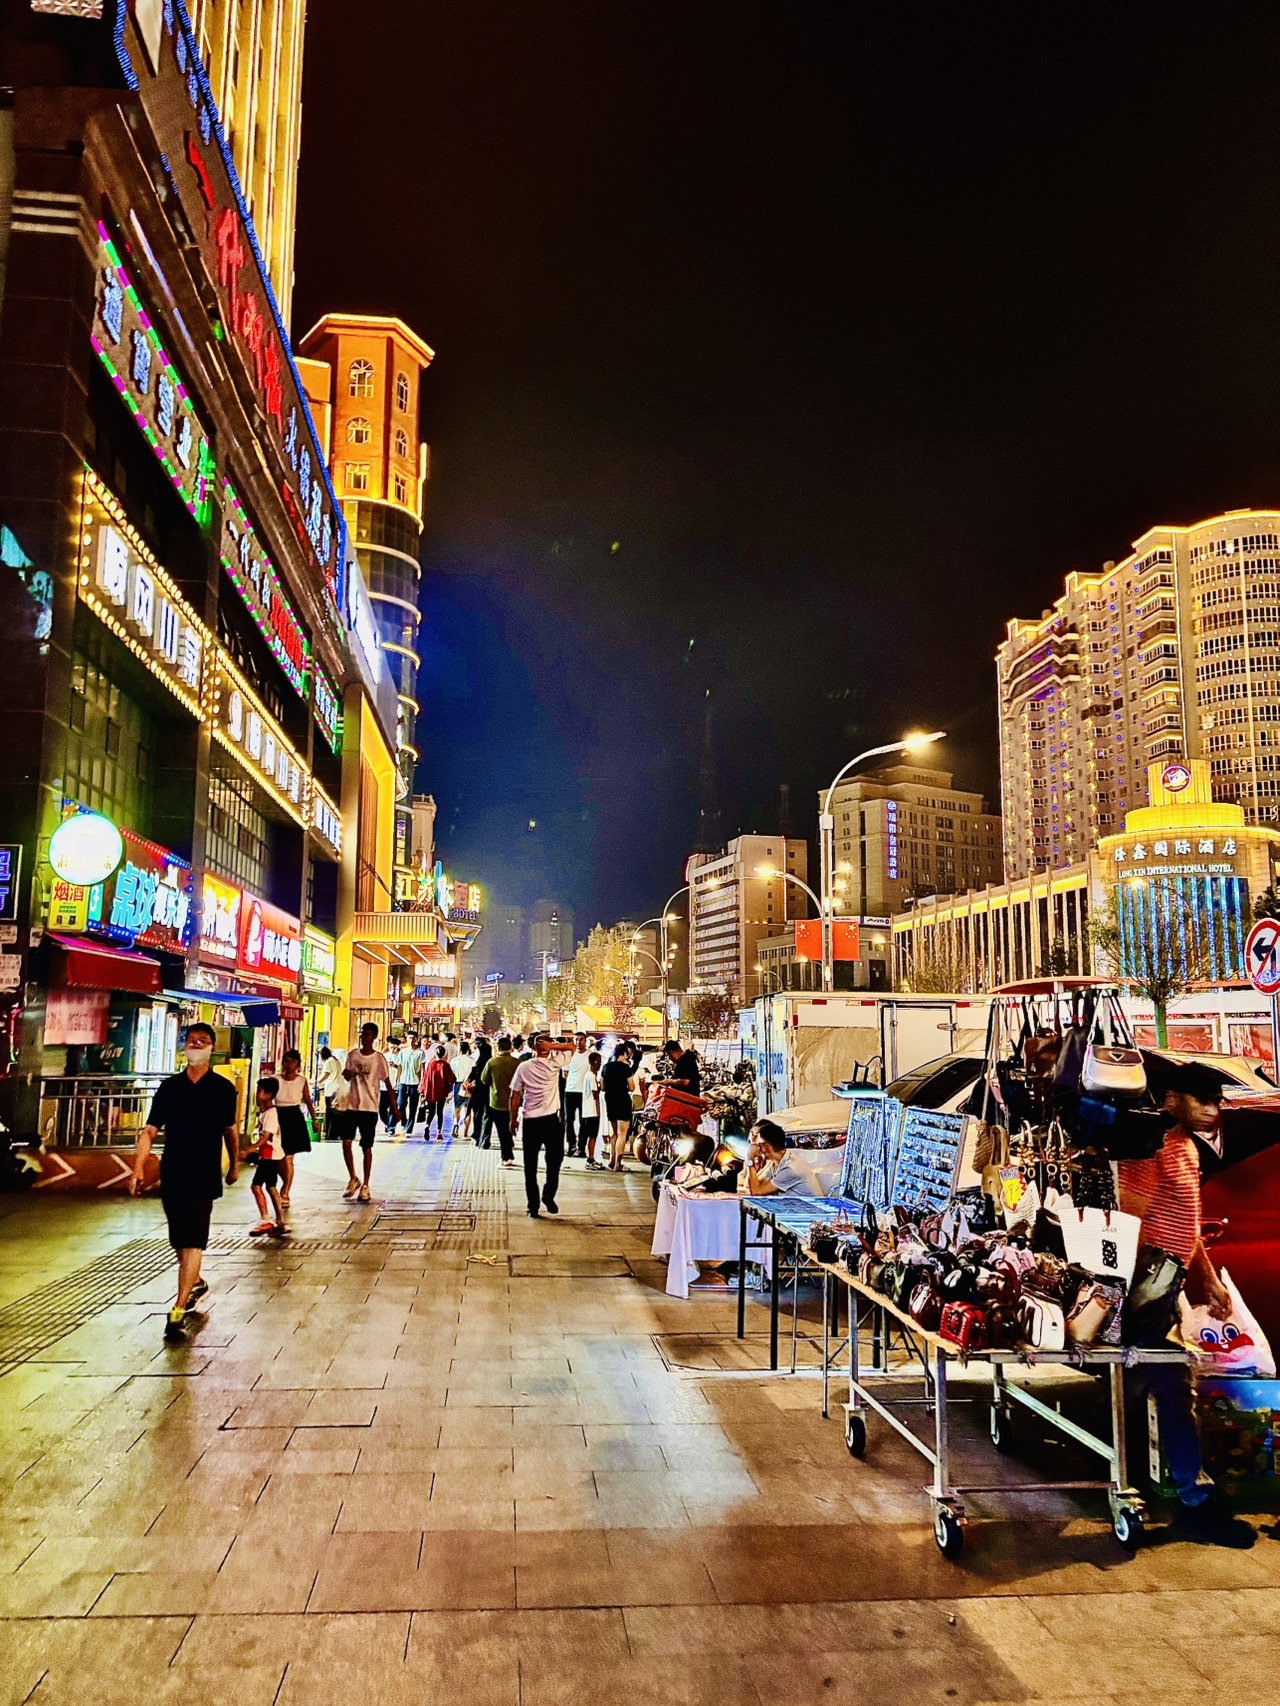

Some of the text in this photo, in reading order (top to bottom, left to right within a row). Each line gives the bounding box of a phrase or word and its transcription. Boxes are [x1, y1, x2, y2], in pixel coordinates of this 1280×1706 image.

[1146, 864, 1208, 876] INTERNATIONAL
[1208, 863, 1234, 873] HOTEL
[53, 881, 85, 902] 烟酒
